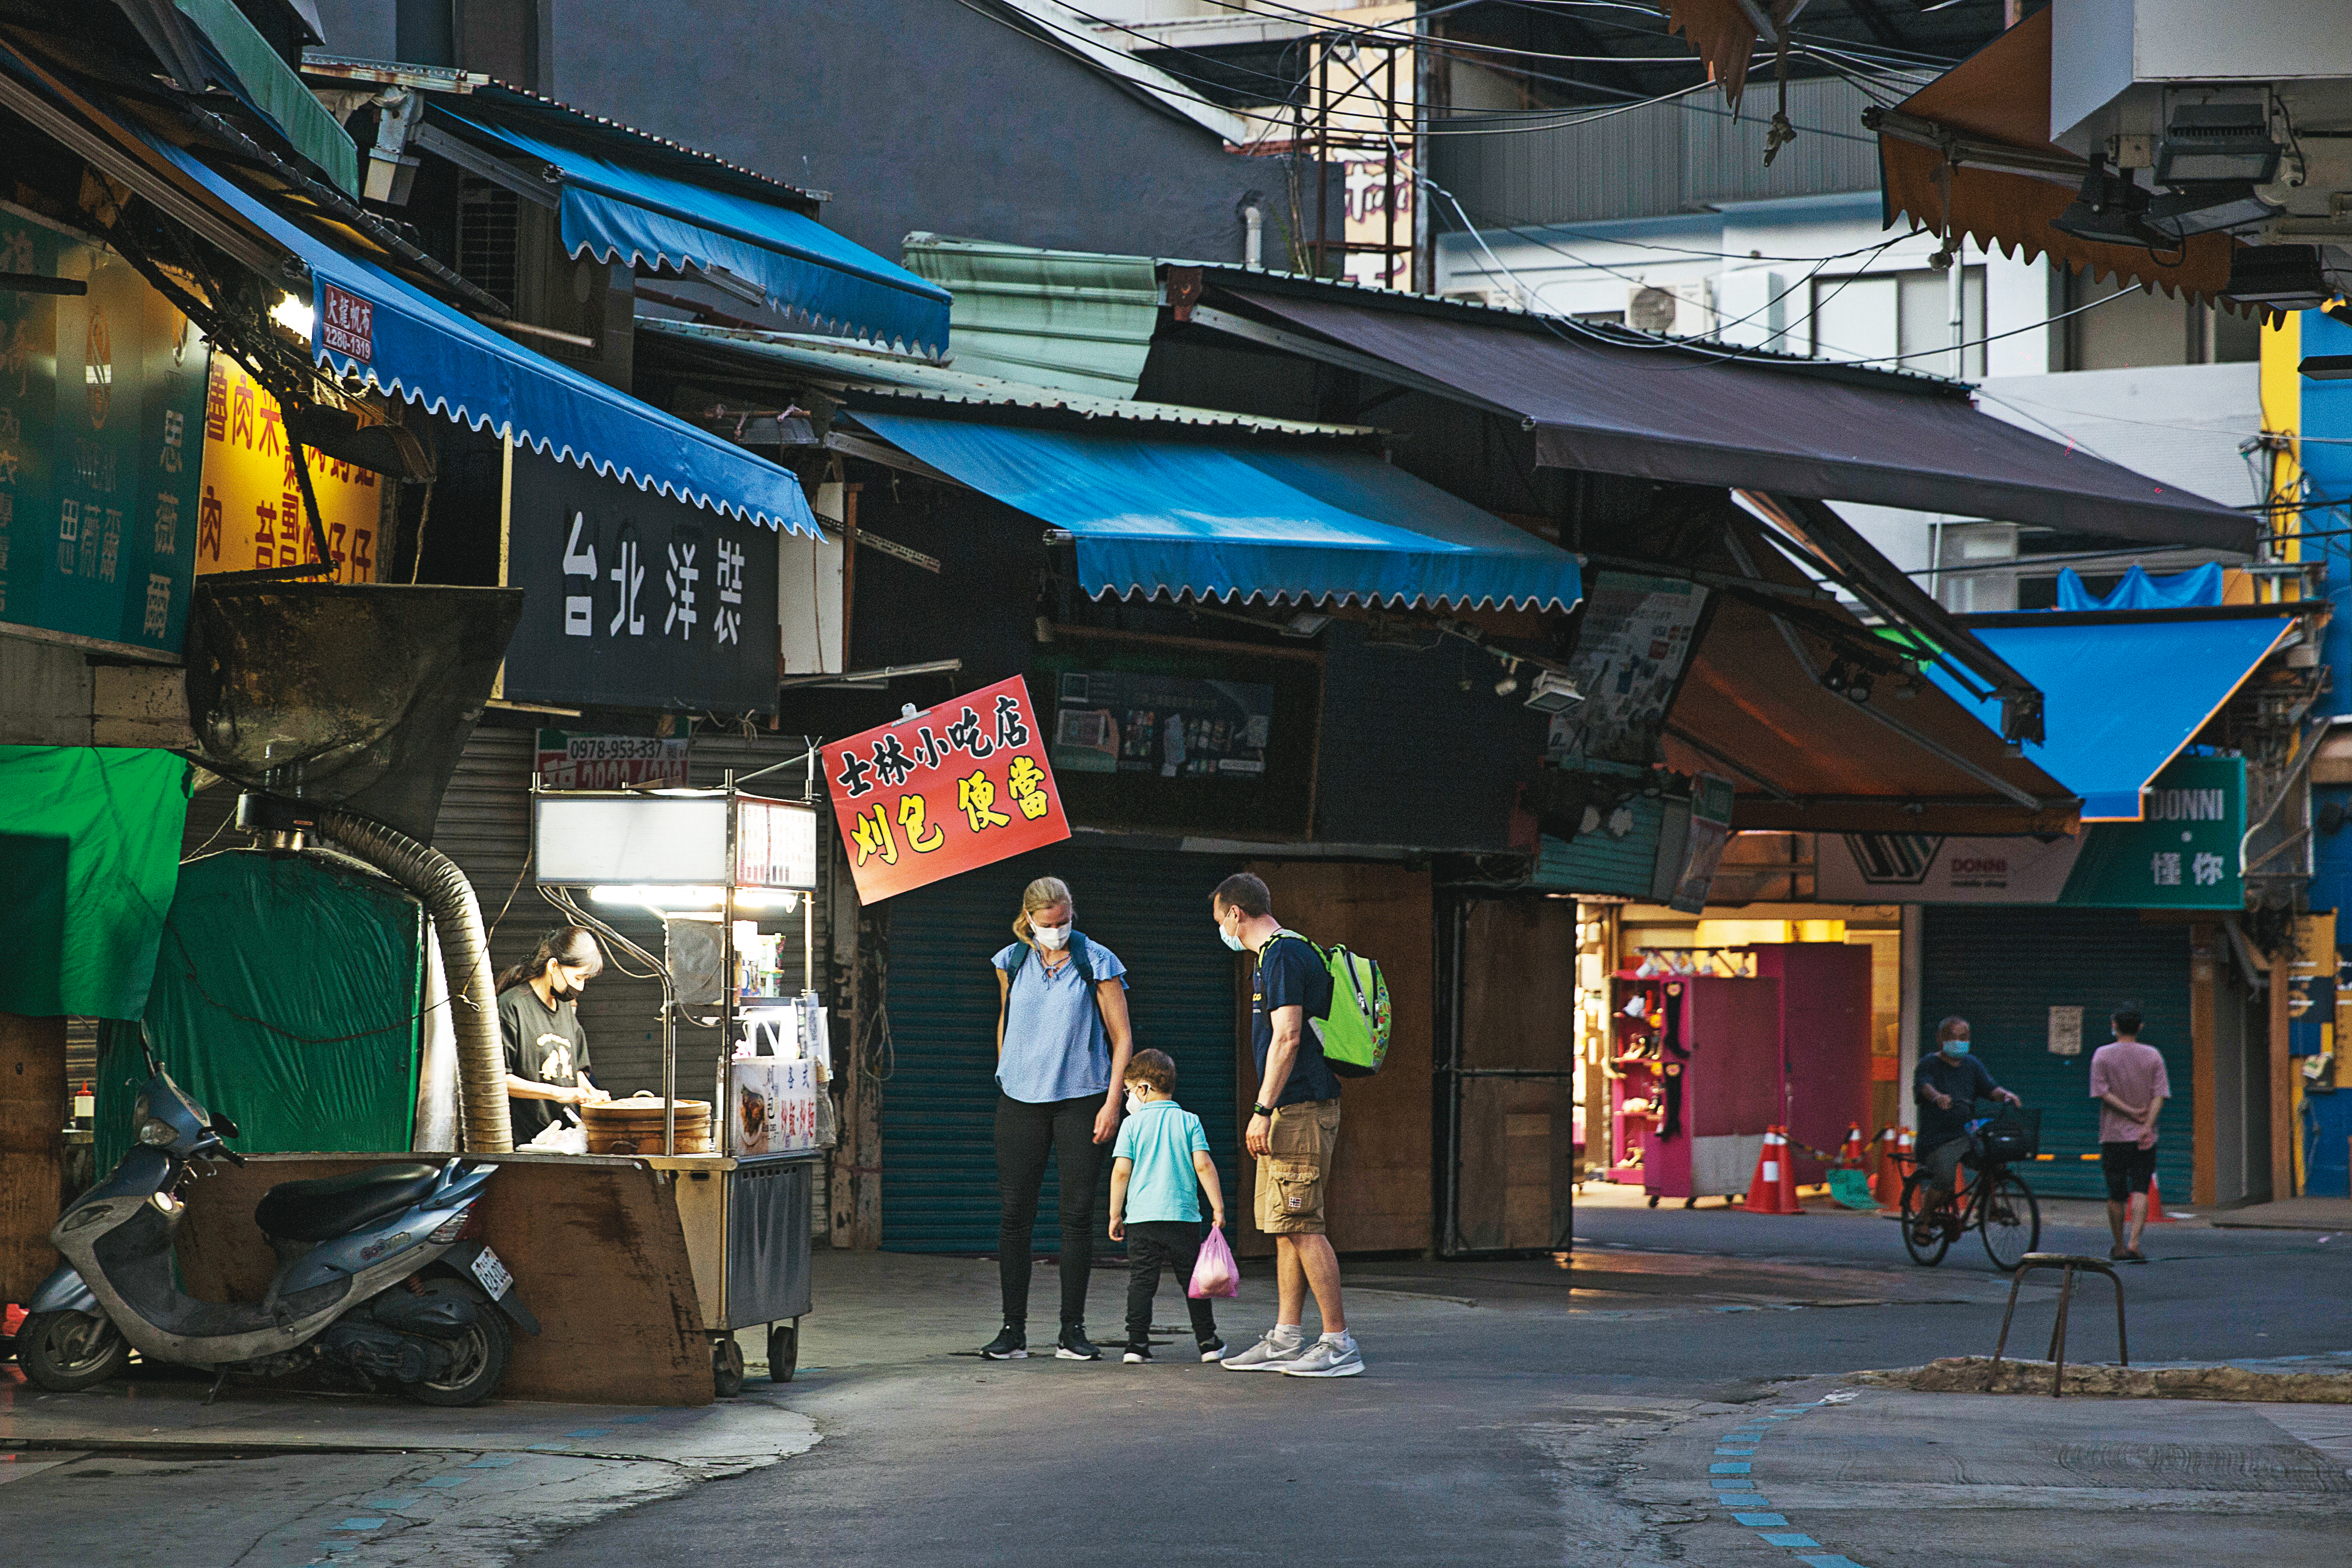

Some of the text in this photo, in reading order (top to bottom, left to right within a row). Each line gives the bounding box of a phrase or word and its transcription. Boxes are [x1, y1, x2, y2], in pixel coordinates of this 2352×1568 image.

[325, 326, 371, 359] 2280-1319
[563, 511, 745, 645] 台北洋裝
[571, 740, 663, 759] 0978-953-337
[837, 695, 1030, 798] 士林小吃店
[850, 794, 945, 867] 刈包
[957, 755, 1049, 833] 便當
[2150, 789, 2224, 820] DONNI
